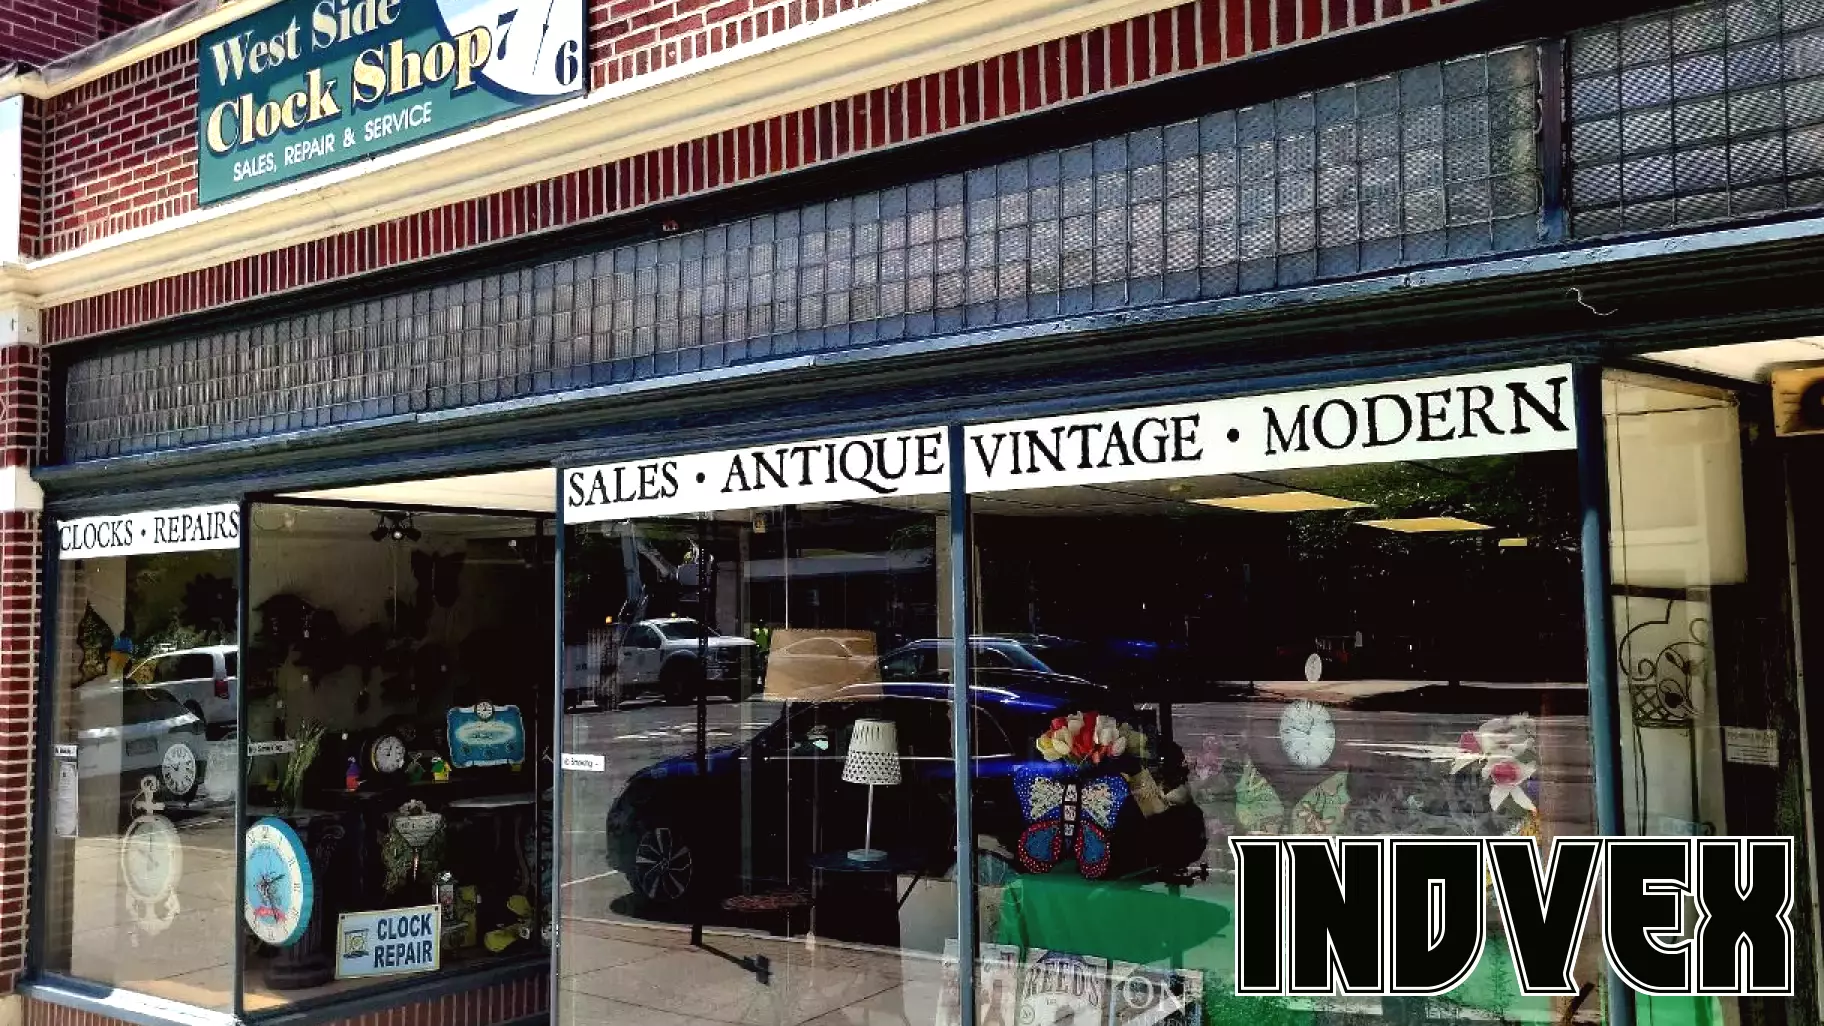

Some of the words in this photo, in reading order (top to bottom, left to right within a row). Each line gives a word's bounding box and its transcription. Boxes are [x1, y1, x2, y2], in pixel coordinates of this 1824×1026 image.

[210, 14, 302, 87] West
[312, 0, 401, 51] Side
[496, 6, 520, 60] 7
[554, 40, 579, 86] 6
[206, 68, 342, 153] Clock
[353, 26, 492, 107] Shop
[233, 152, 277, 181] SALES,
[284, 133, 335, 166] REPAIR
[343, 128, 356, 148] &
[364, 101, 433, 142] SERVICE
[970, 413, 1204, 478] VINTAGE
[1262, 376, 1570, 456] MODERN
[569, 460, 679, 508] SALES
[720, 432, 945, 494] ANTIQUE
[60, 519, 133, 551] CLOCKS
[154, 510, 240, 544] REPAIRS
[374, 940, 433, 968] REPAIR
[377, 913, 433, 941] CLOCK
